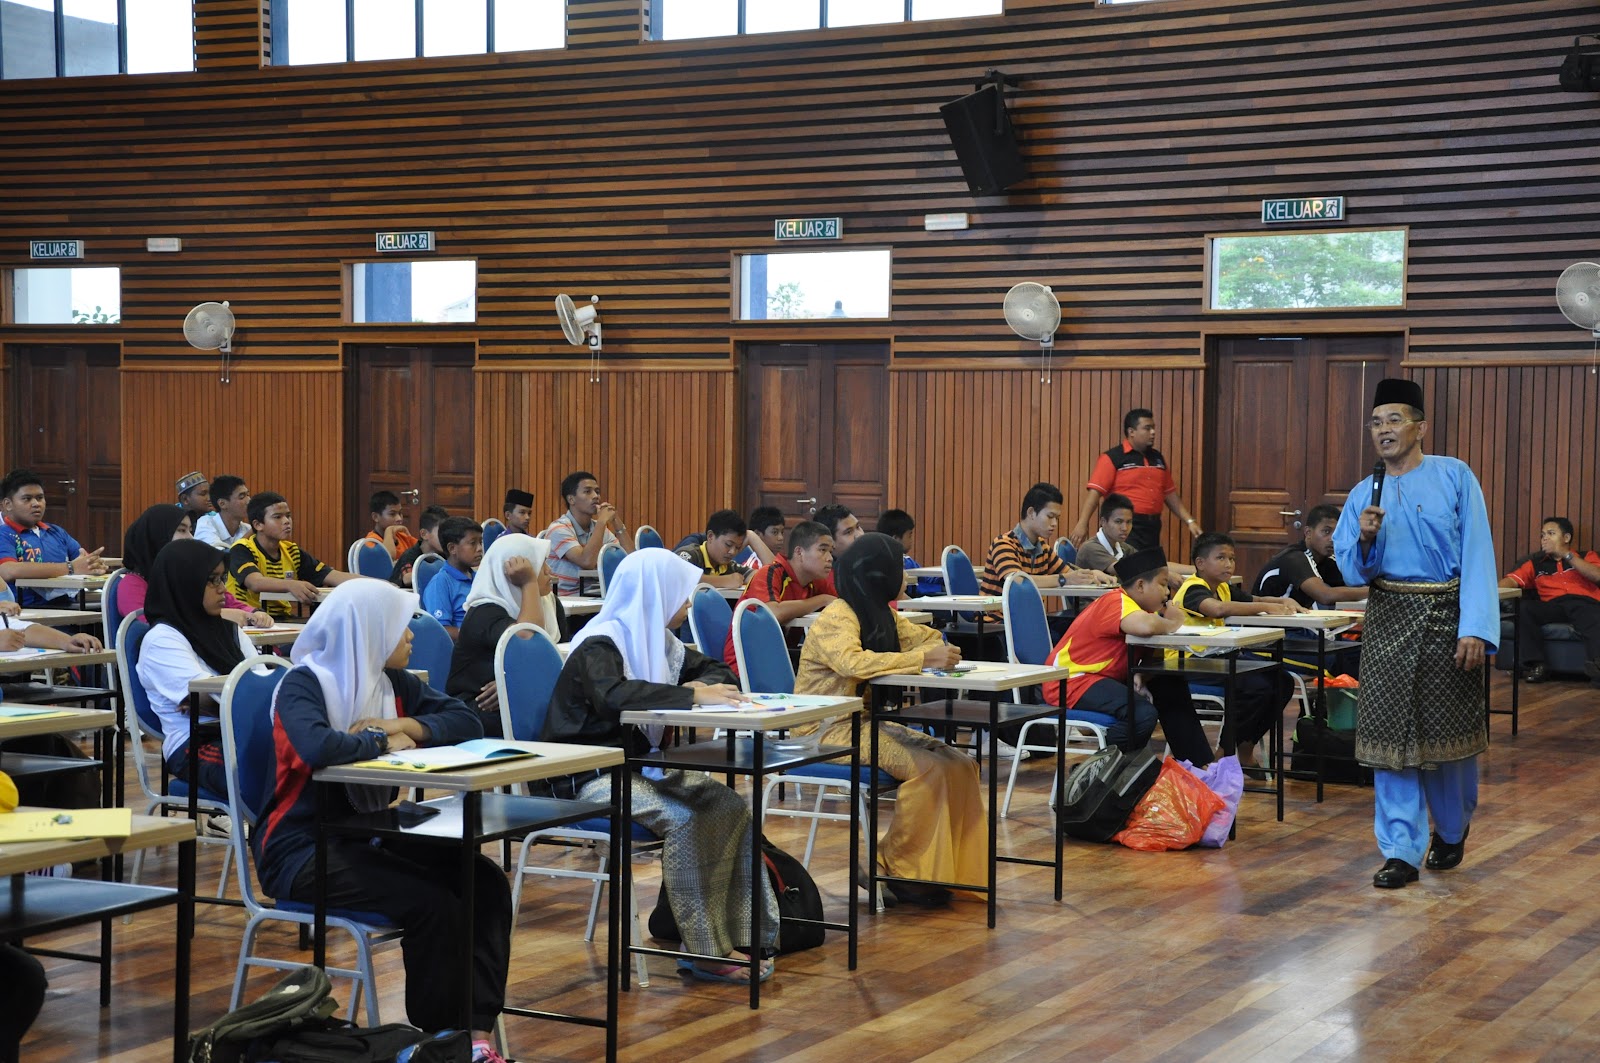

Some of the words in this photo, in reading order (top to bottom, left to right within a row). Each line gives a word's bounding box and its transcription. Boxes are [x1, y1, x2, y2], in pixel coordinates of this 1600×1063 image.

[1267, 200, 1323, 220] KELUAR
[779, 221, 824, 238] KELUAR
[33, 242, 67, 257] KELUAR
[379, 234, 418, 249] KELUAR
